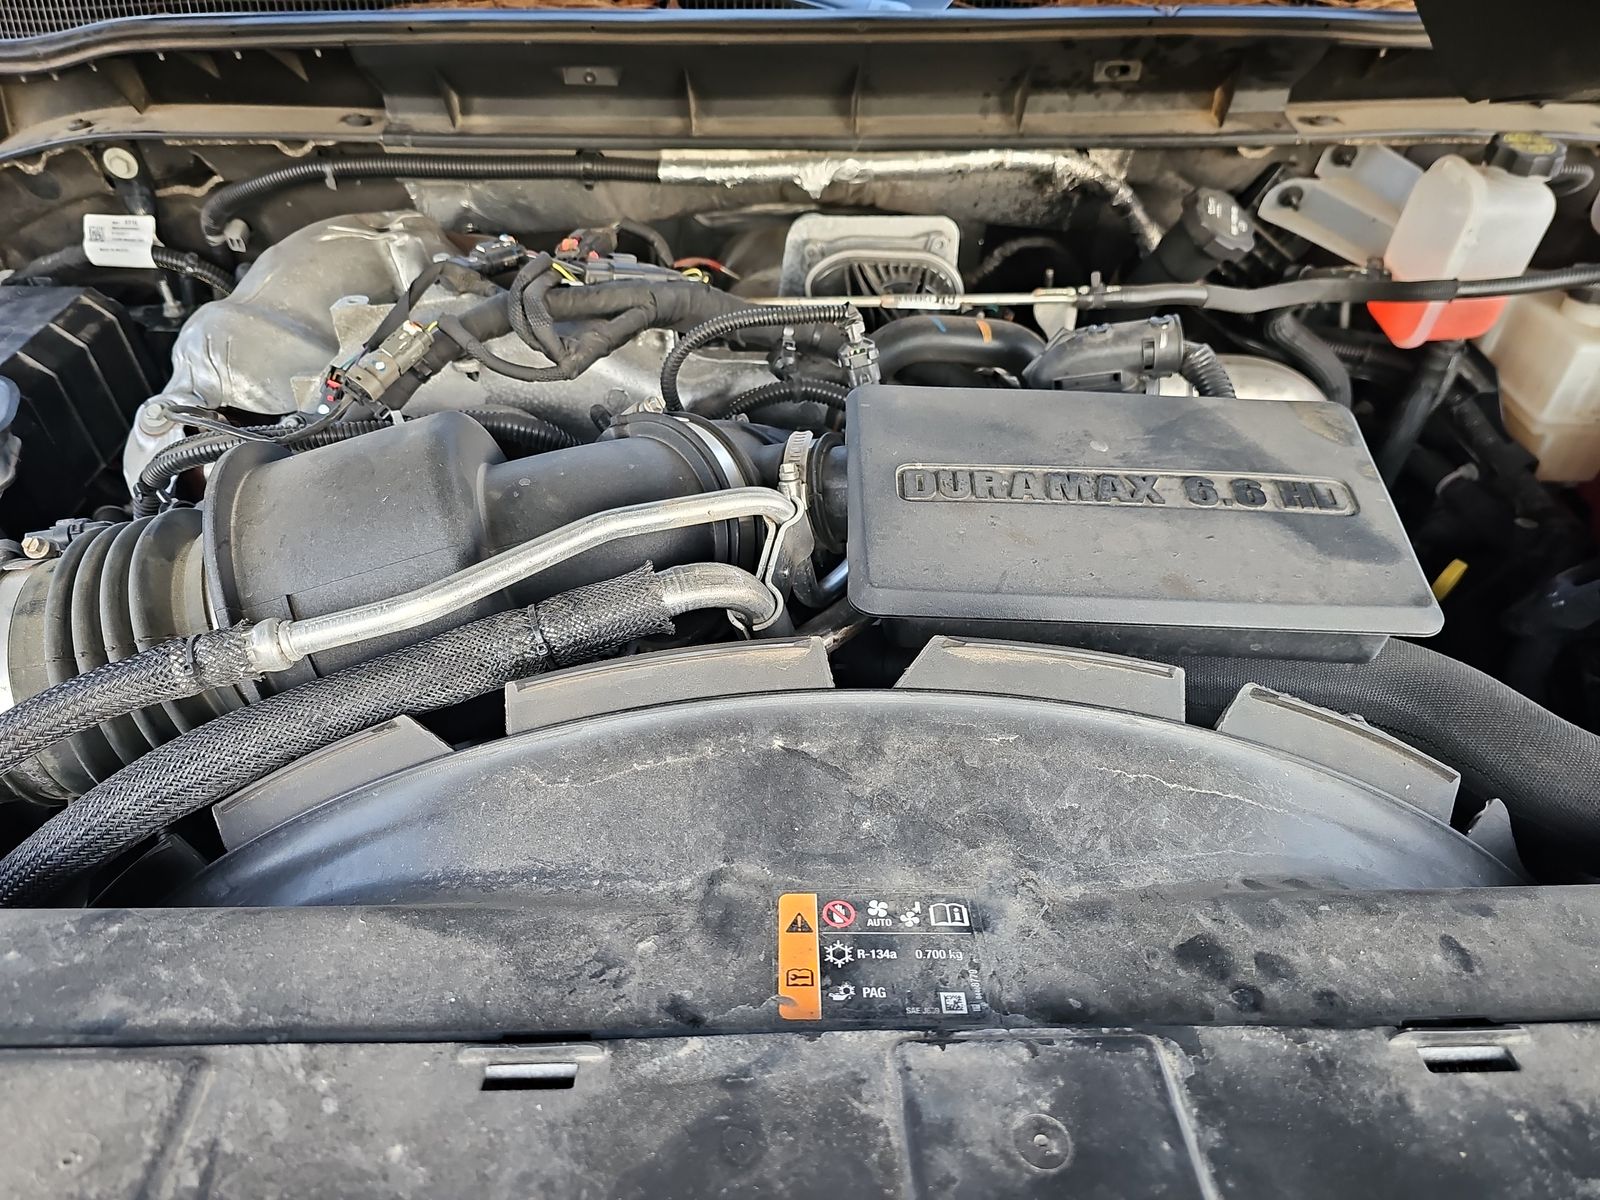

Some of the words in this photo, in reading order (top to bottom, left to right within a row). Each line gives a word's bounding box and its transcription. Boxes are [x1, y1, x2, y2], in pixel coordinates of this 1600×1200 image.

[901, 467, 1166, 505] DURAMAX
[1181, 475, 1269, 509] 6.6
[1273, 479, 1340, 511] HD
[866, 918, 893, 927] AUTO
[857, 949, 898, 960] R-134a
[915, 949, 947, 960] 0.700
[948, 949, 964, 961] kg
[862, 987, 887, 999] PAG
[905, 1006, 922, 1015] SAE
